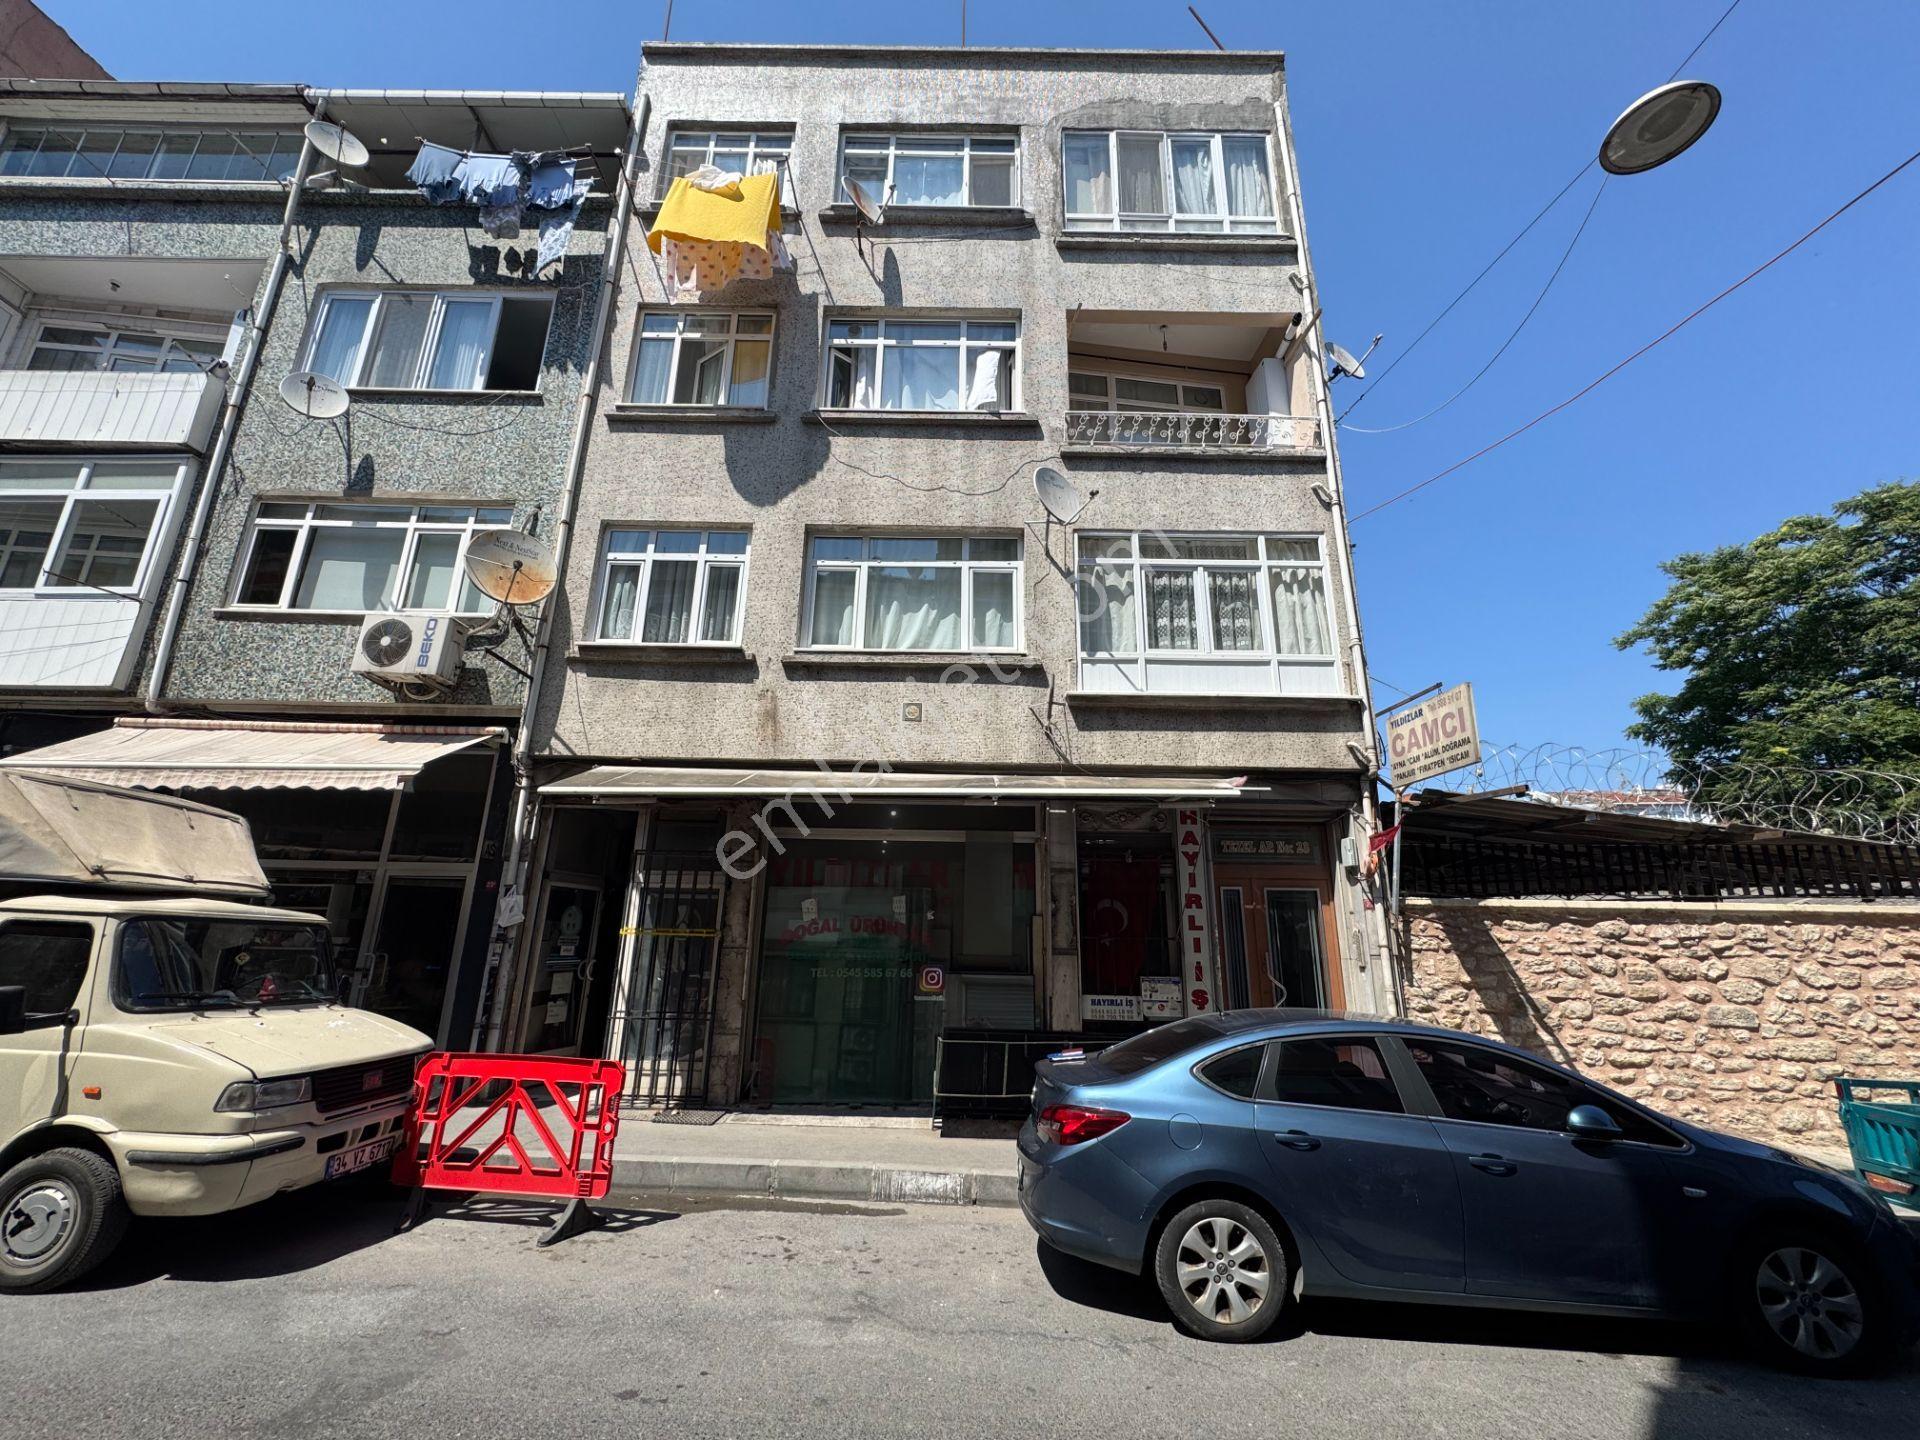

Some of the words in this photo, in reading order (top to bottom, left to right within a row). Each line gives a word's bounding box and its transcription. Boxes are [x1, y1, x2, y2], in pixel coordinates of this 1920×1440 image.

[417, 618, 438, 667] BEKO
[1390, 708, 1423, 730] YILDIZLAR
[1391, 707, 1466, 757] CAMCI
[1441, 736, 1471, 753] DOĞRAMA
[1179, 810, 1204, 953] HAYIRLI
[836, 968, 861, 977] 0545
[864, 968, 883, 977] 585
[1090, 998, 1123, 1007] HAYIRLI
[1125, 997, 1134, 1009] İŞ
[334, 1155, 347, 1172] 34
[354, 1148, 366, 1167] VZ
